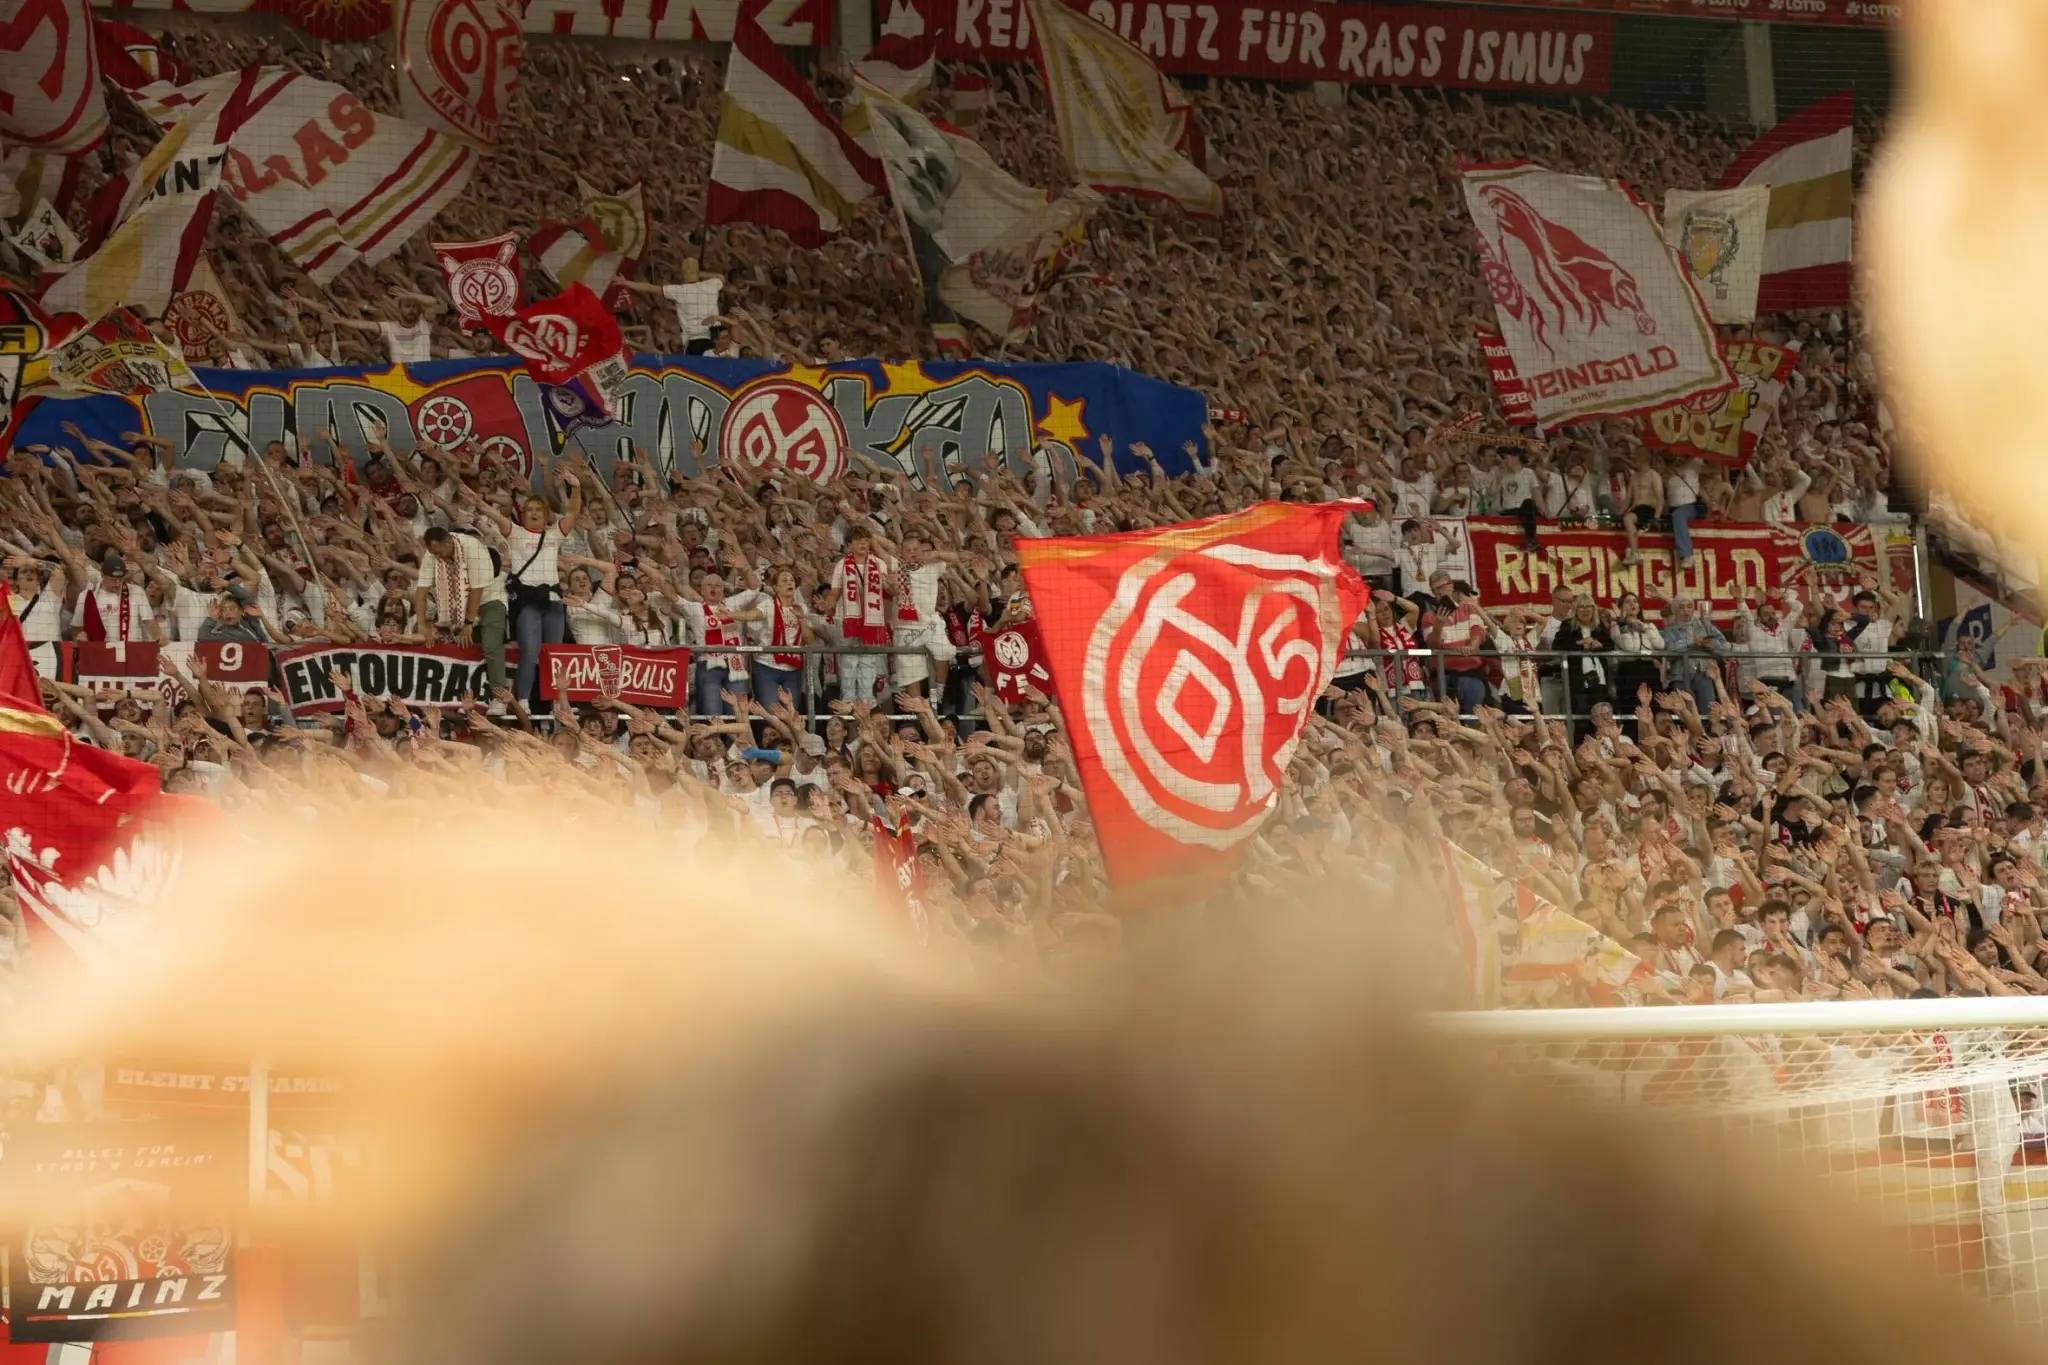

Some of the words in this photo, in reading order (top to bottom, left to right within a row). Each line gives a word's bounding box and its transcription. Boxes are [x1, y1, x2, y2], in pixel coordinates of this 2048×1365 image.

[1862, 4, 1900, 18] LOTTO
[1239, 8, 1326, 69] FÜR
[1339, 18, 1446, 78] RASS
[1458, 28, 1594, 85] ISMUS
[1495, 543, 1767, 600] RHEINGOLD
[284, 652, 517, 706] ENTOURAG
[37, 1275, 227, 1311] MAINZ
